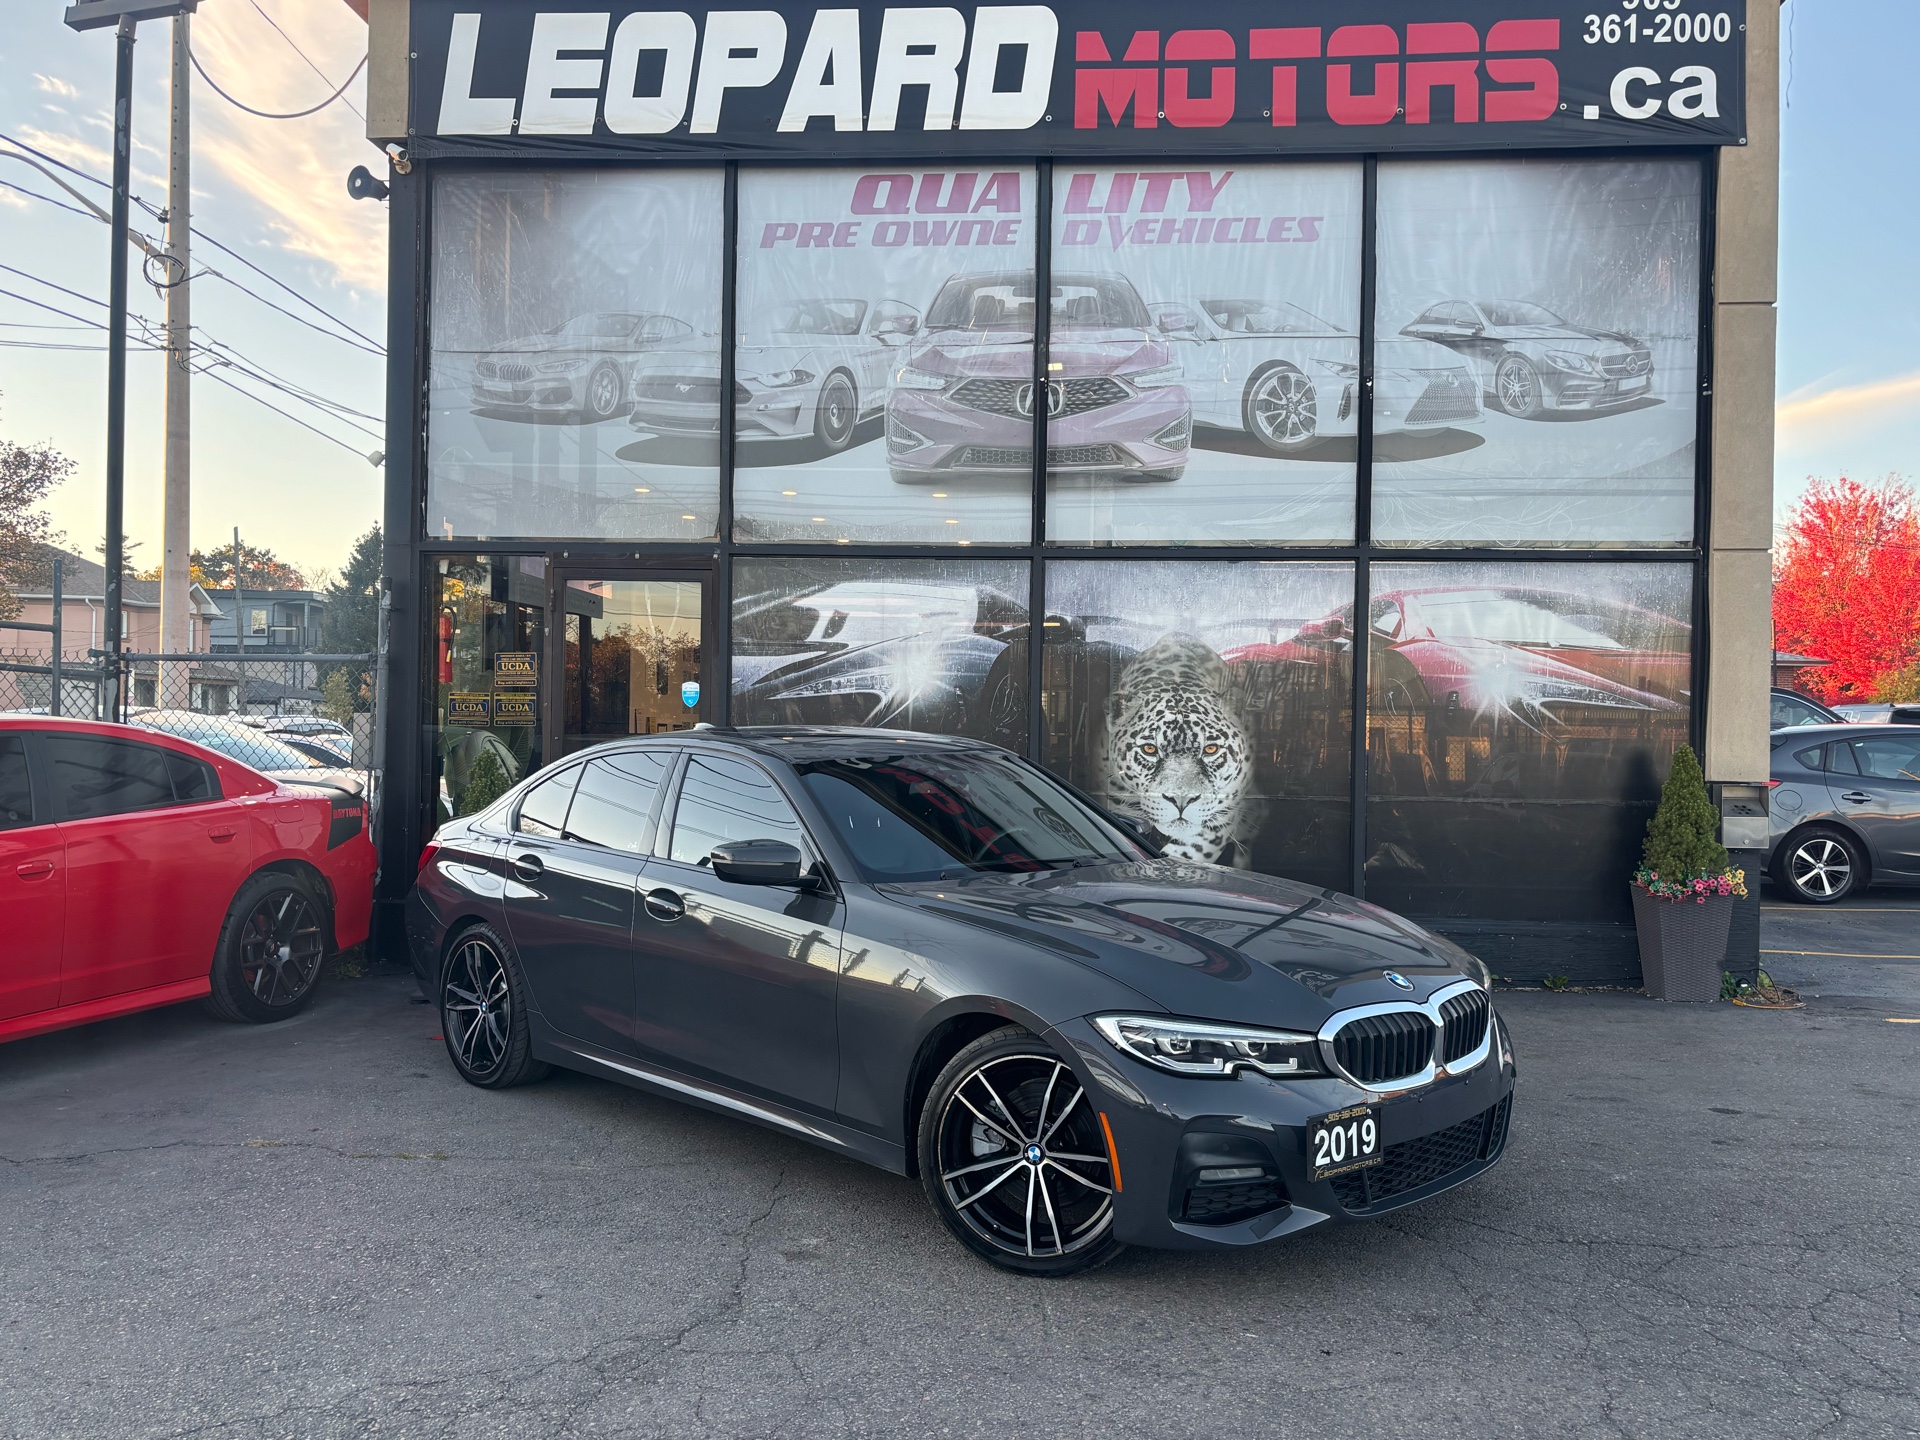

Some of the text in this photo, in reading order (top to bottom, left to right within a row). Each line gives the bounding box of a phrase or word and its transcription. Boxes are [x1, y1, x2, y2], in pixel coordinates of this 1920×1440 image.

[1583, 12, 1731, 44] 361-2000
[436, 4, 1059, 135] LEOPARD
[1074, 19, 1560, 129] MOTORS
[759, 221, 862, 249] PRE
[501, 662, 531, 671] UCDA
[455, 703, 483, 711] UCDA
[501, 703, 530, 711] UCDA
[1314, 1118, 1376, 1167] 2019
